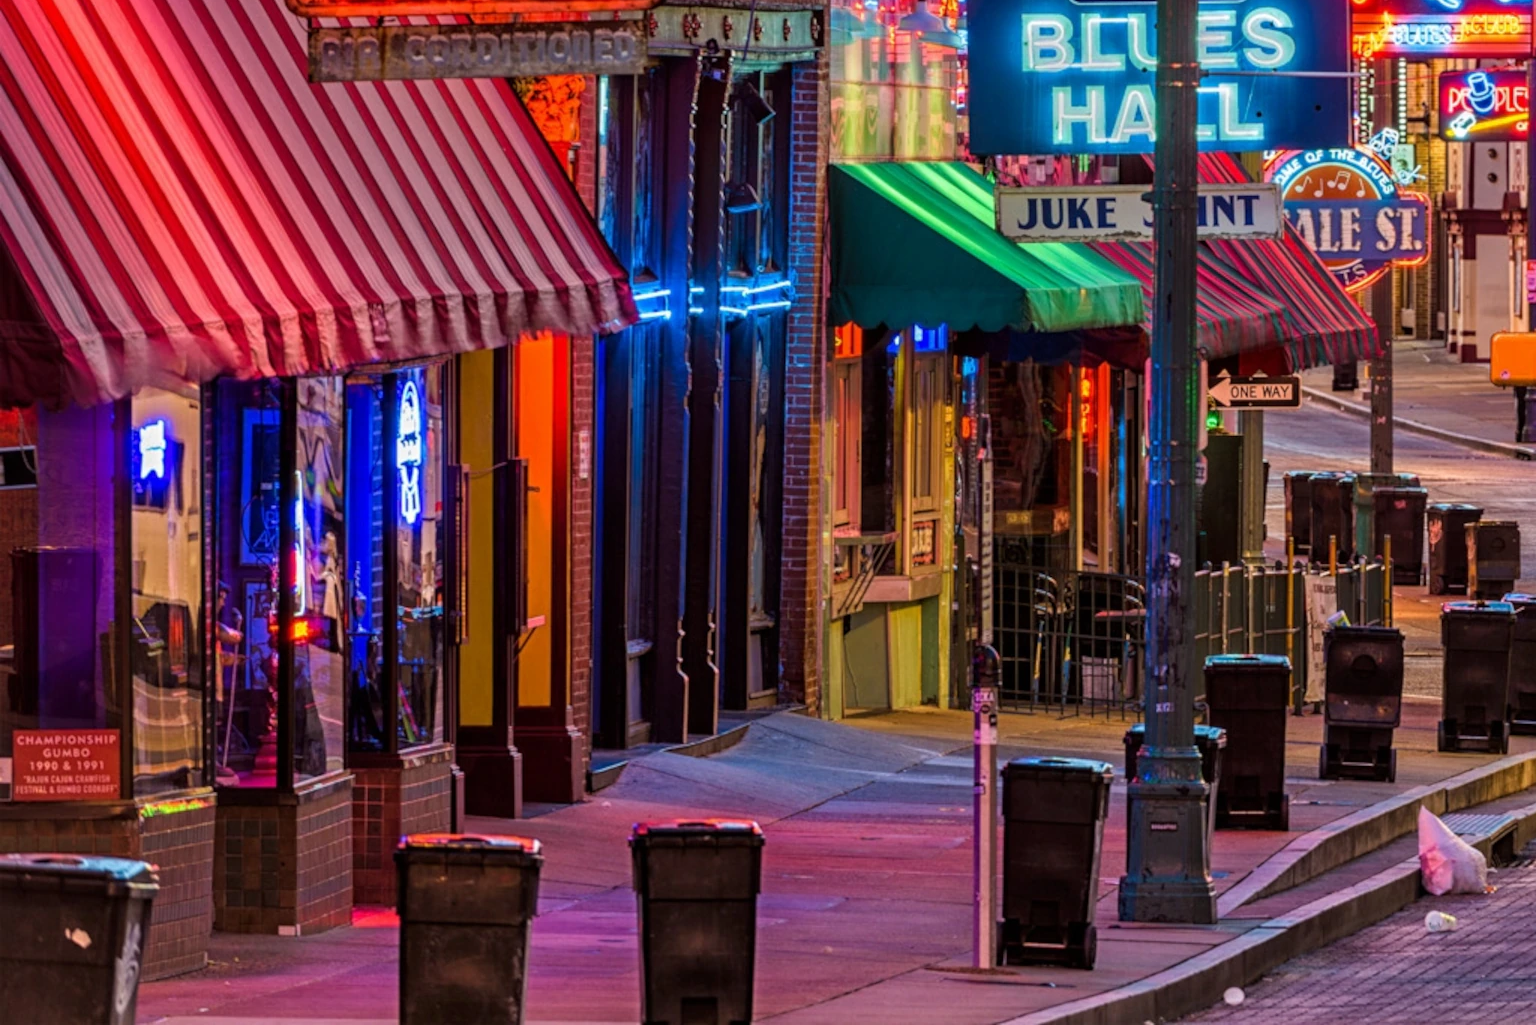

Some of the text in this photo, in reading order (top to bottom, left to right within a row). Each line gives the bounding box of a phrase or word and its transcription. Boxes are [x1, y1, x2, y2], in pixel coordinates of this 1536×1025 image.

[1021, 6, 1297, 73] BLUES
[1391, 23, 1454, 46] BLUES
[1470, 14, 1521, 35] CLUB
[1052, 82, 1265, 145] HAL
[1274, 148, 1396, 195] OME OF THE BLUES
[1017, 193, 1260, 232] JUKE INT
[1283, 206, 1423, 252] ALE ST.
[1230, 385, 1290, 399] ONE WAY
[16, 734, 117, 746] CHAMPIONSHIP
[42, 747, 91, 759] GUMBO
[29, 759, 105, 772] 1990 & 1991
[15, 784, 48, 795] FESTIVAL
[49, 785, 55, 795] &
[56, 785, 82, 794] GUMBO
[50, 774, 74, 785] CAJUN
[74, 774, 111, 784] CRAWFISH
